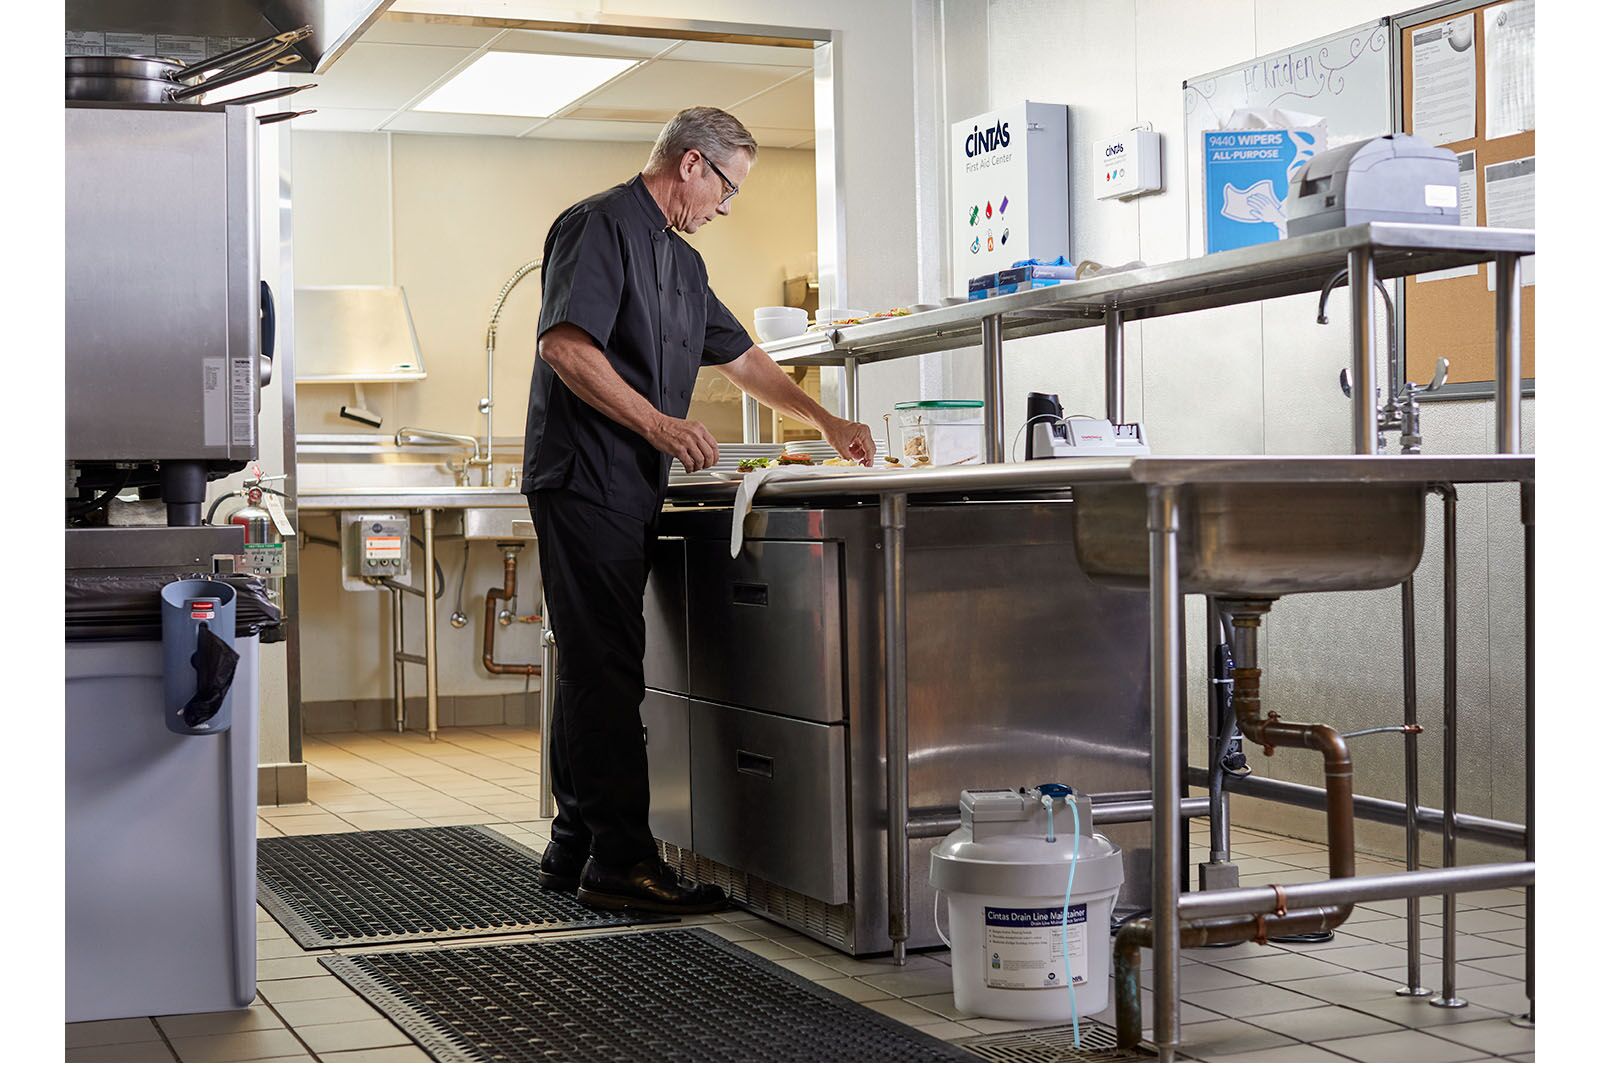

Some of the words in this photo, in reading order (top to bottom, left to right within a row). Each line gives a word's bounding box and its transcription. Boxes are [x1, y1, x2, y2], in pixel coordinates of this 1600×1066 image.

[1209, 135, 1236, 147] 9440
[1238, 134, 1282, 146] WIPERS
[1213, 149, 1279, 161] ALL-PURPOSE
[966, 162, 979, 173] First
[980, 158, 991, 170] Aid
[991, 154, 1012, 167] Center
[987, 911, 1009, 921] Cintas
[1011, 912, 1031, 921] Drain
[1033, 912, 1048, 921] Line
[1050, 909, 1085, 920] Maitainer
